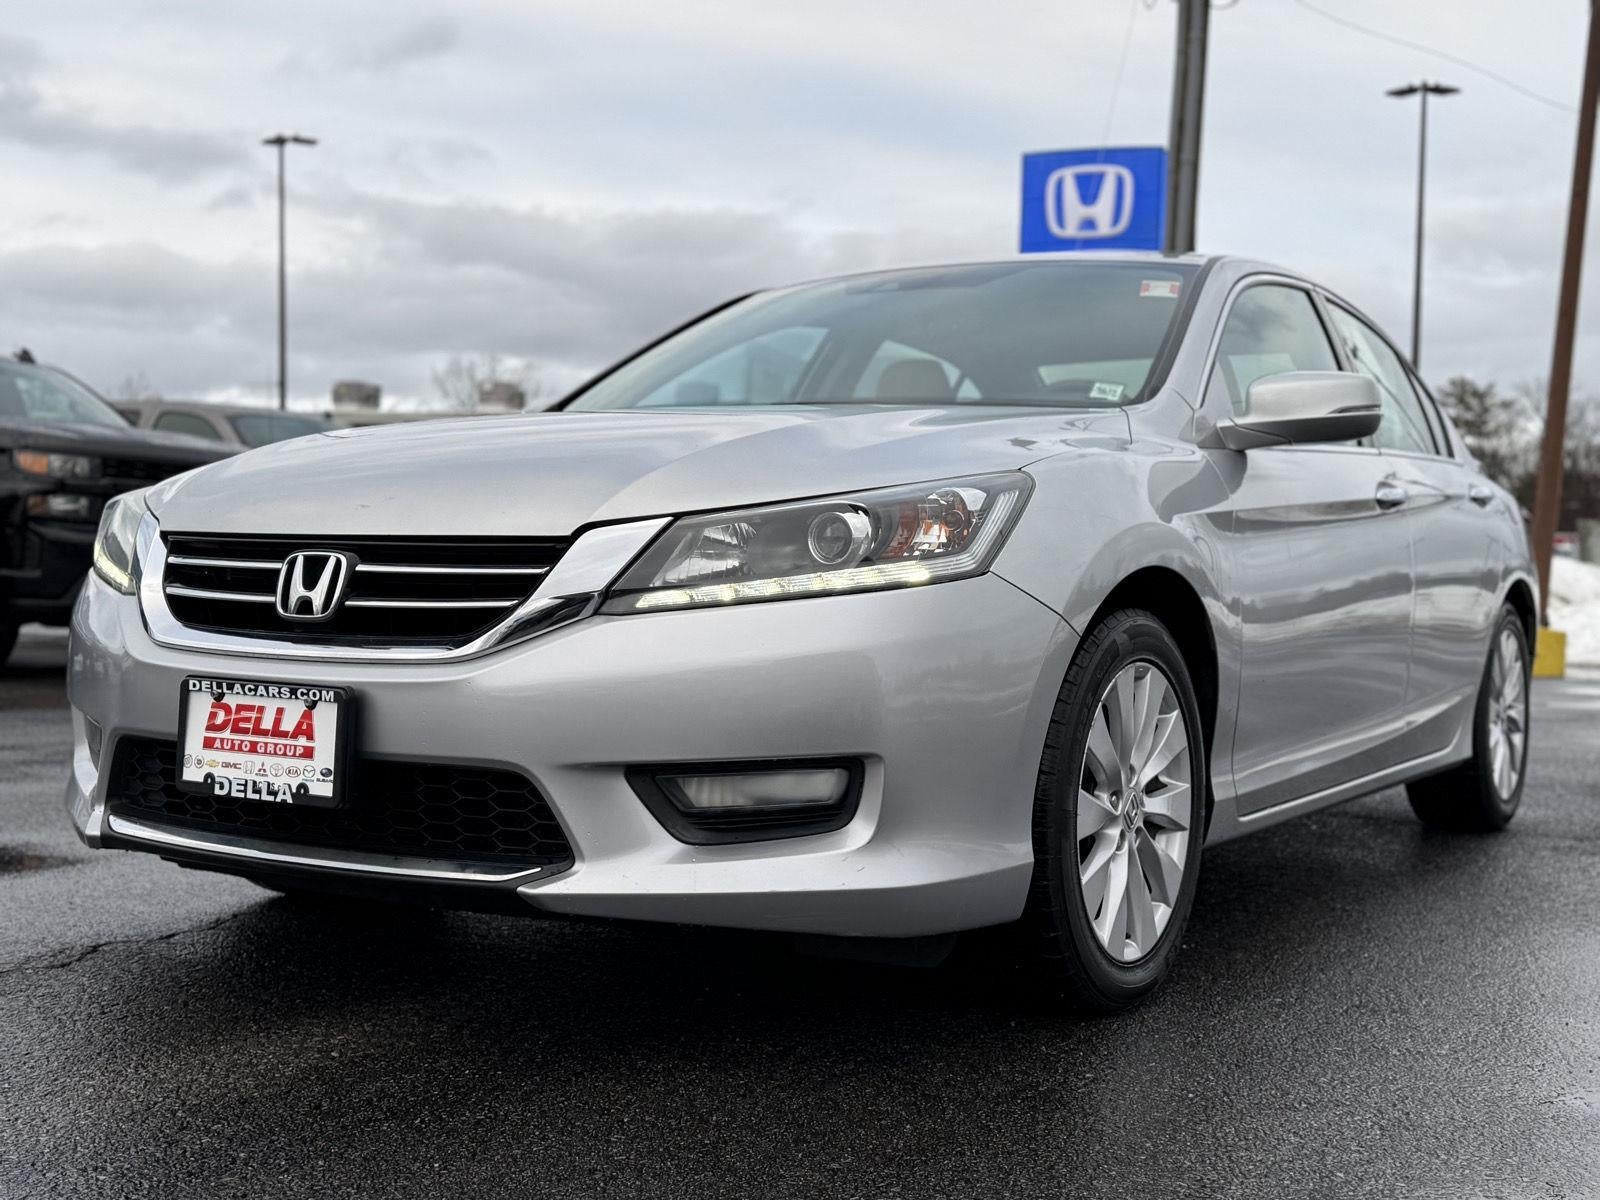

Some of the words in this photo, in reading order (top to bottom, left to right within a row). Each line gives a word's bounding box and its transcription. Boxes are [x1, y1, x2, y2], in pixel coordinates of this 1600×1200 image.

[188, 679, 335, 702] DELLACARS.COM
[204, 702, 316, 742] DELLA
[213, 738, 251, 753] AUTO
[256, 741, 305, 757] GROUP
[221, 761, 242, 770] GMC
[213, 776, 294, 804] DELLA
